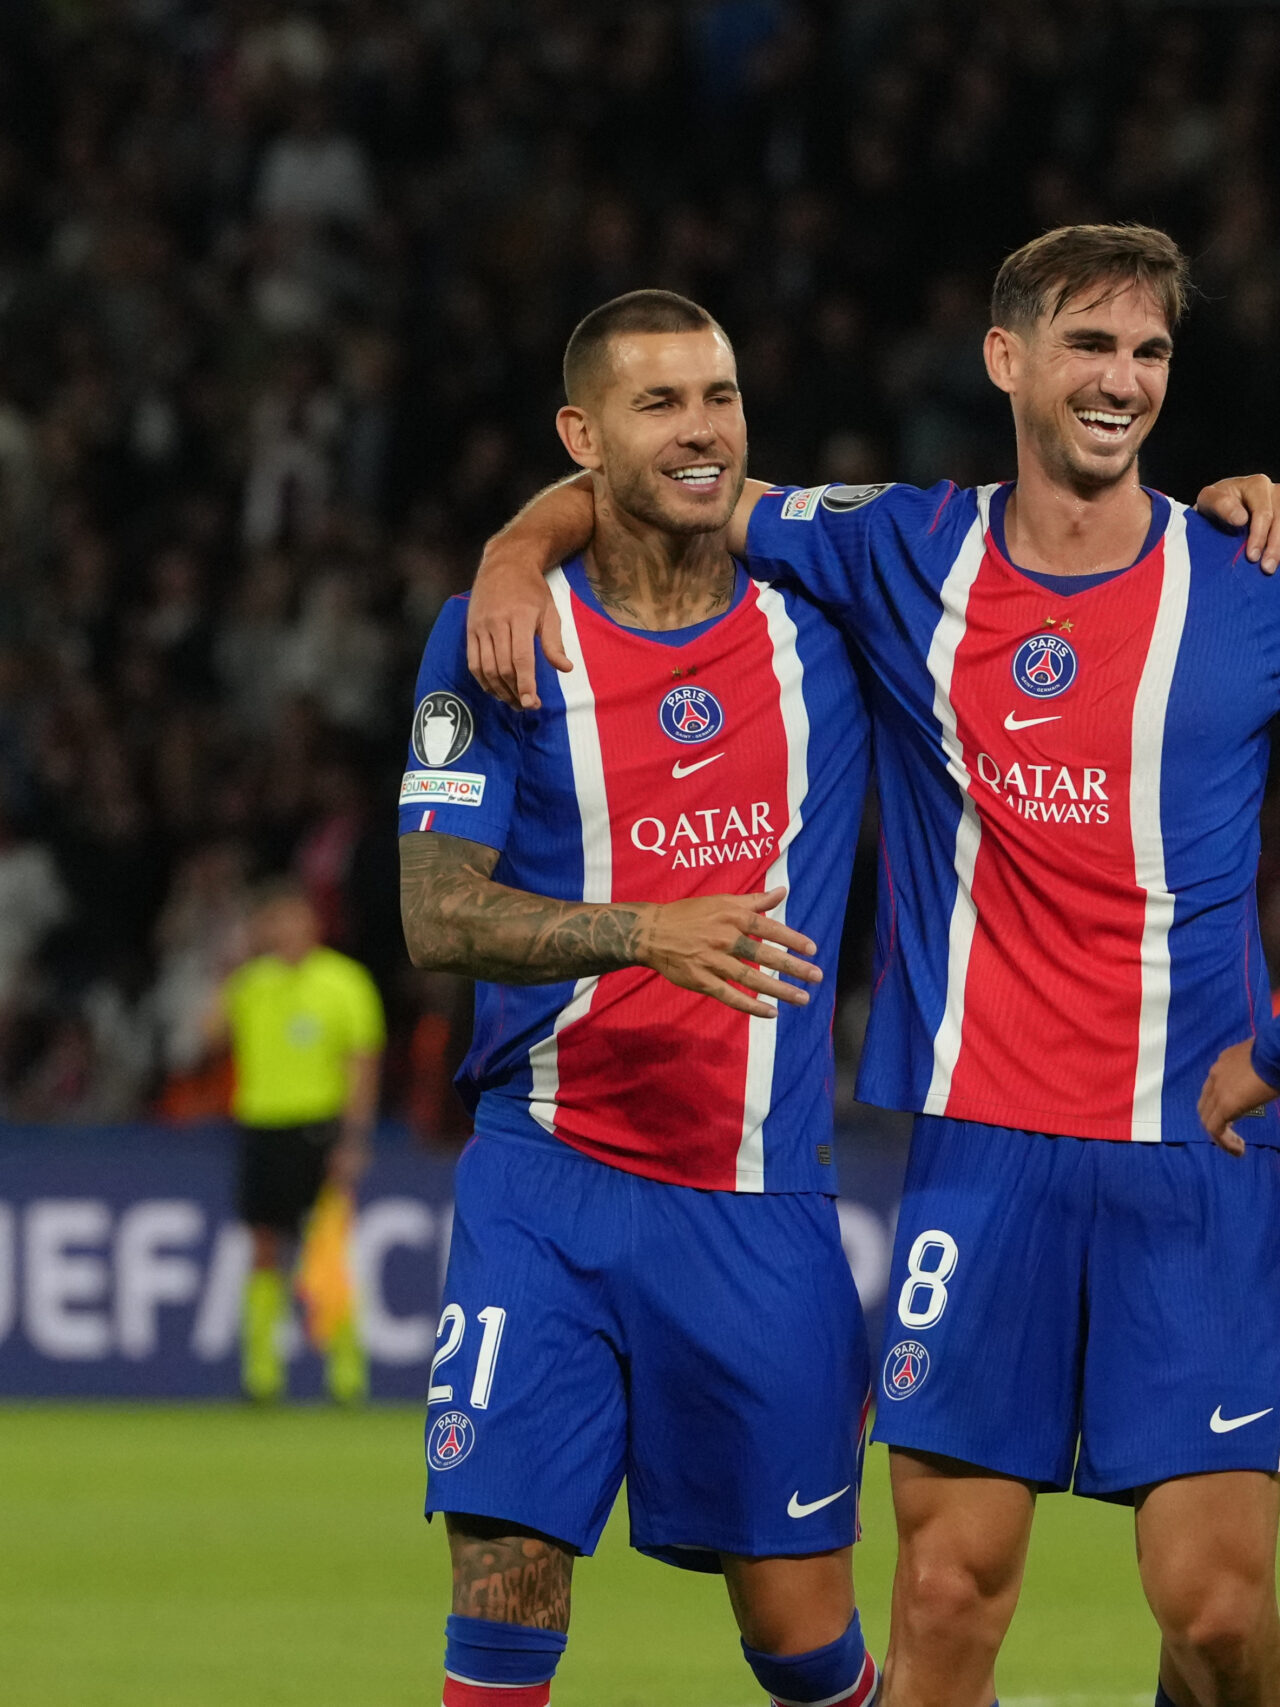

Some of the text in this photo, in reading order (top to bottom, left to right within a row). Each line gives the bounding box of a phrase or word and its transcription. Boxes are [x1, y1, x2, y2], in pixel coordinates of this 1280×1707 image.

[1028, 638, 1069, 657] PARIS
[666, 689, 706, 707] PARIS
[402, 780, 482, 796] FOUNDATION
[977, 752, 1109, 800] QATAR
[1006, 794, 1110, 824] AIRWAYS
[630, 801, 775, 857] QATAR
[671, 836, 775, 870] AIRWAYS
[898, 1229, 958, 1330] 8
[427, 1303, 506, 1410] 21
[894, 1344, 925, 1360] PARIS
[437, 1414, 469, 1430] PARIS
